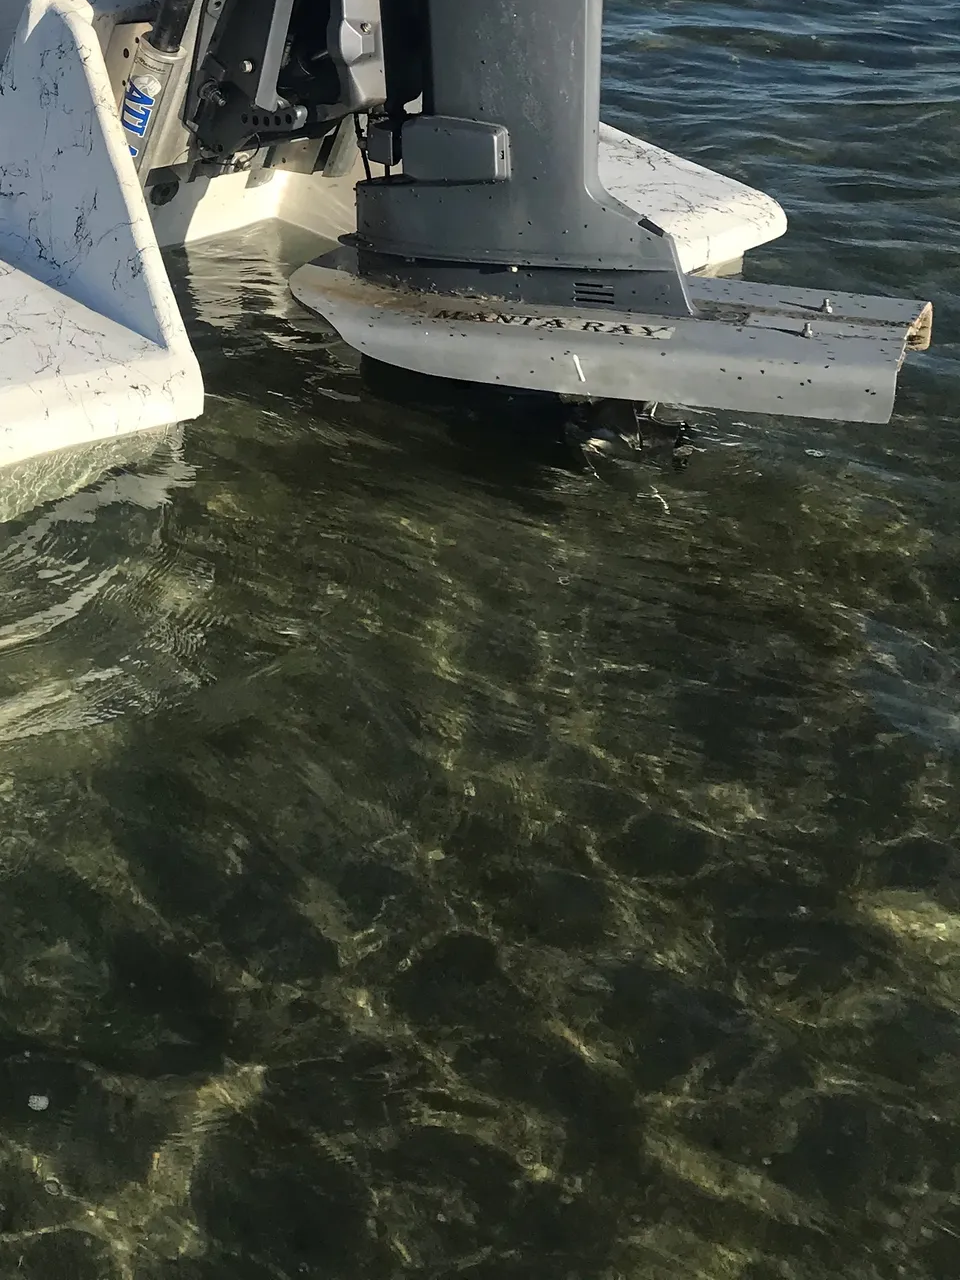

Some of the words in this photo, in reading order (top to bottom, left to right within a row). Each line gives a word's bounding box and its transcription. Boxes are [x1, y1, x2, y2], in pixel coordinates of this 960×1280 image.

[121, 78, 155, 157] ATL
[434, 309, 566, 329] MANTA
[580, 320, 674, 337] RAY
